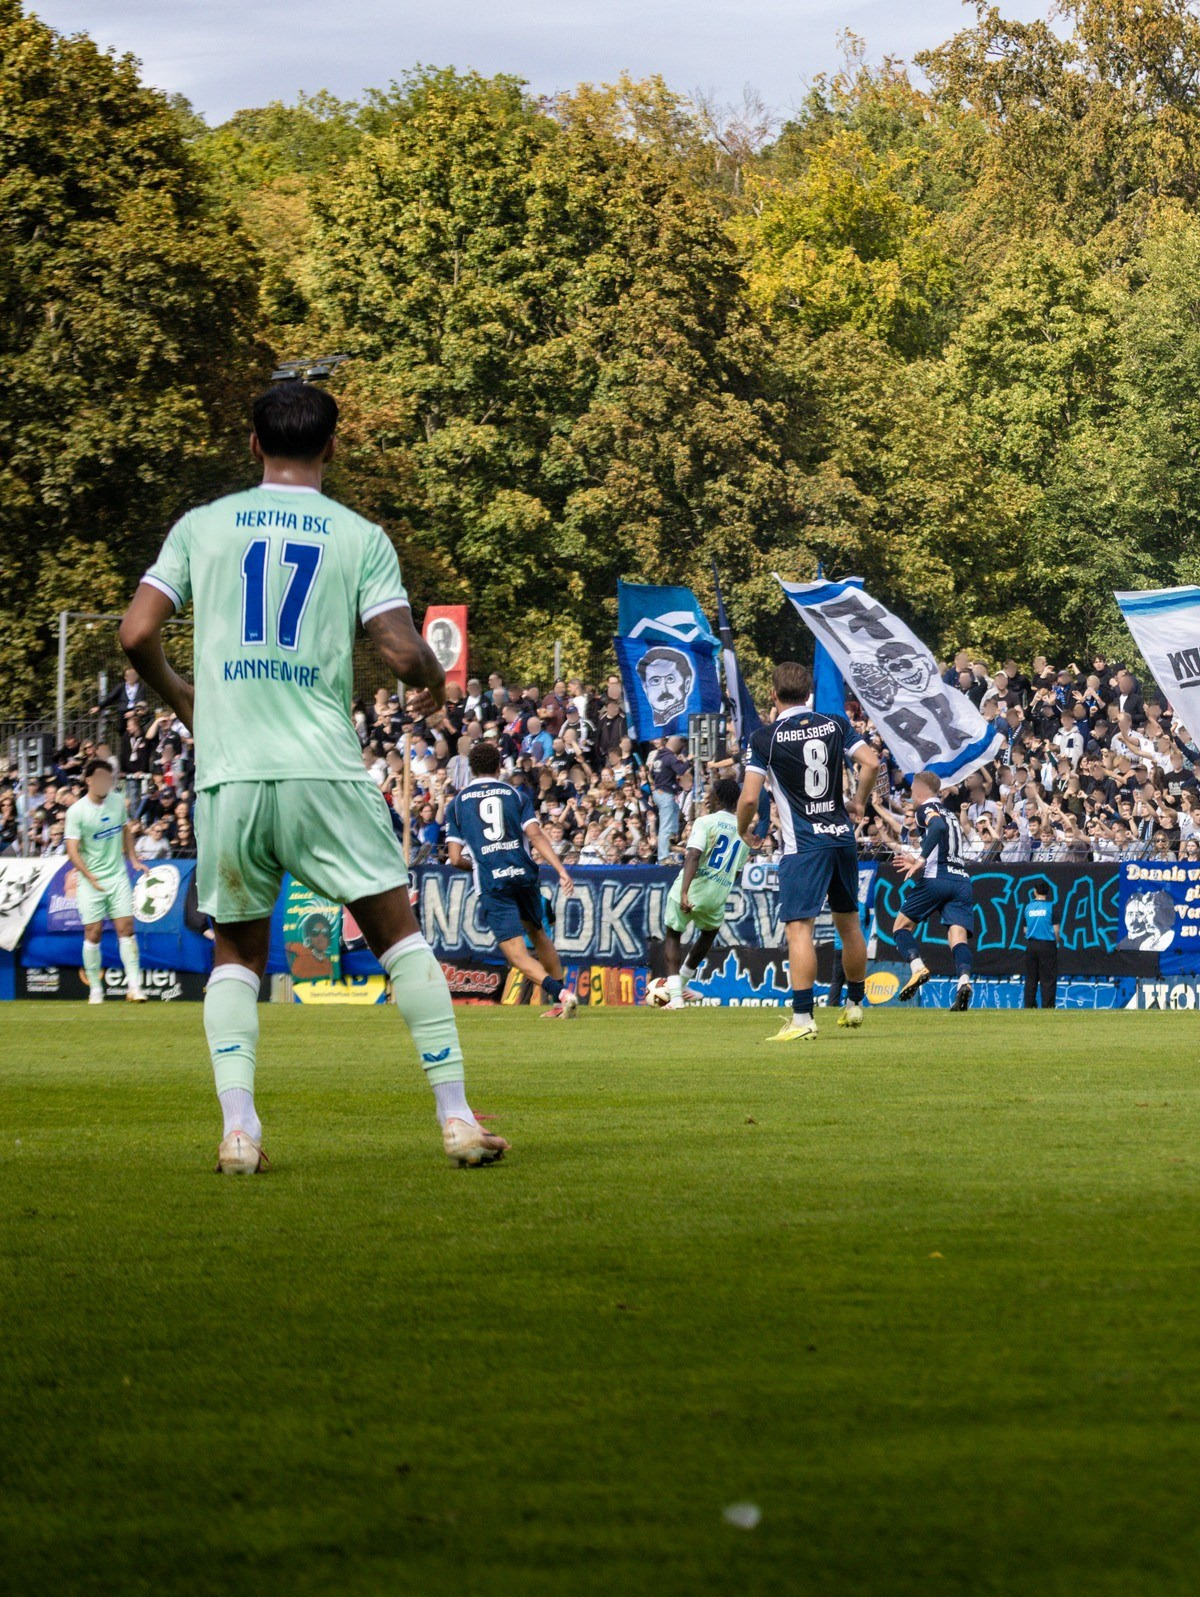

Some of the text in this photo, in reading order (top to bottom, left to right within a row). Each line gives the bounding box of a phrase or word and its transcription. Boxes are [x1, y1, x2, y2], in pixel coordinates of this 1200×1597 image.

[236, 510, 333, 535] HERTHA BSC
[240, 537, 324, 651] 17
[776, 721, 836, 742] BABELSBERG
[803, 738, 830, 799] 8
[461, 788, 513, 802] BABELSBERG
[479, 796, 505, 841] 9
[812, 823, 850, 836] Katjes
[707, 833, 742, 874] 21
[491, 865, 526, 879] Katjes
[1126, 863, 1186, 882] Damals
[1181, 924, 1198, 937] zu
